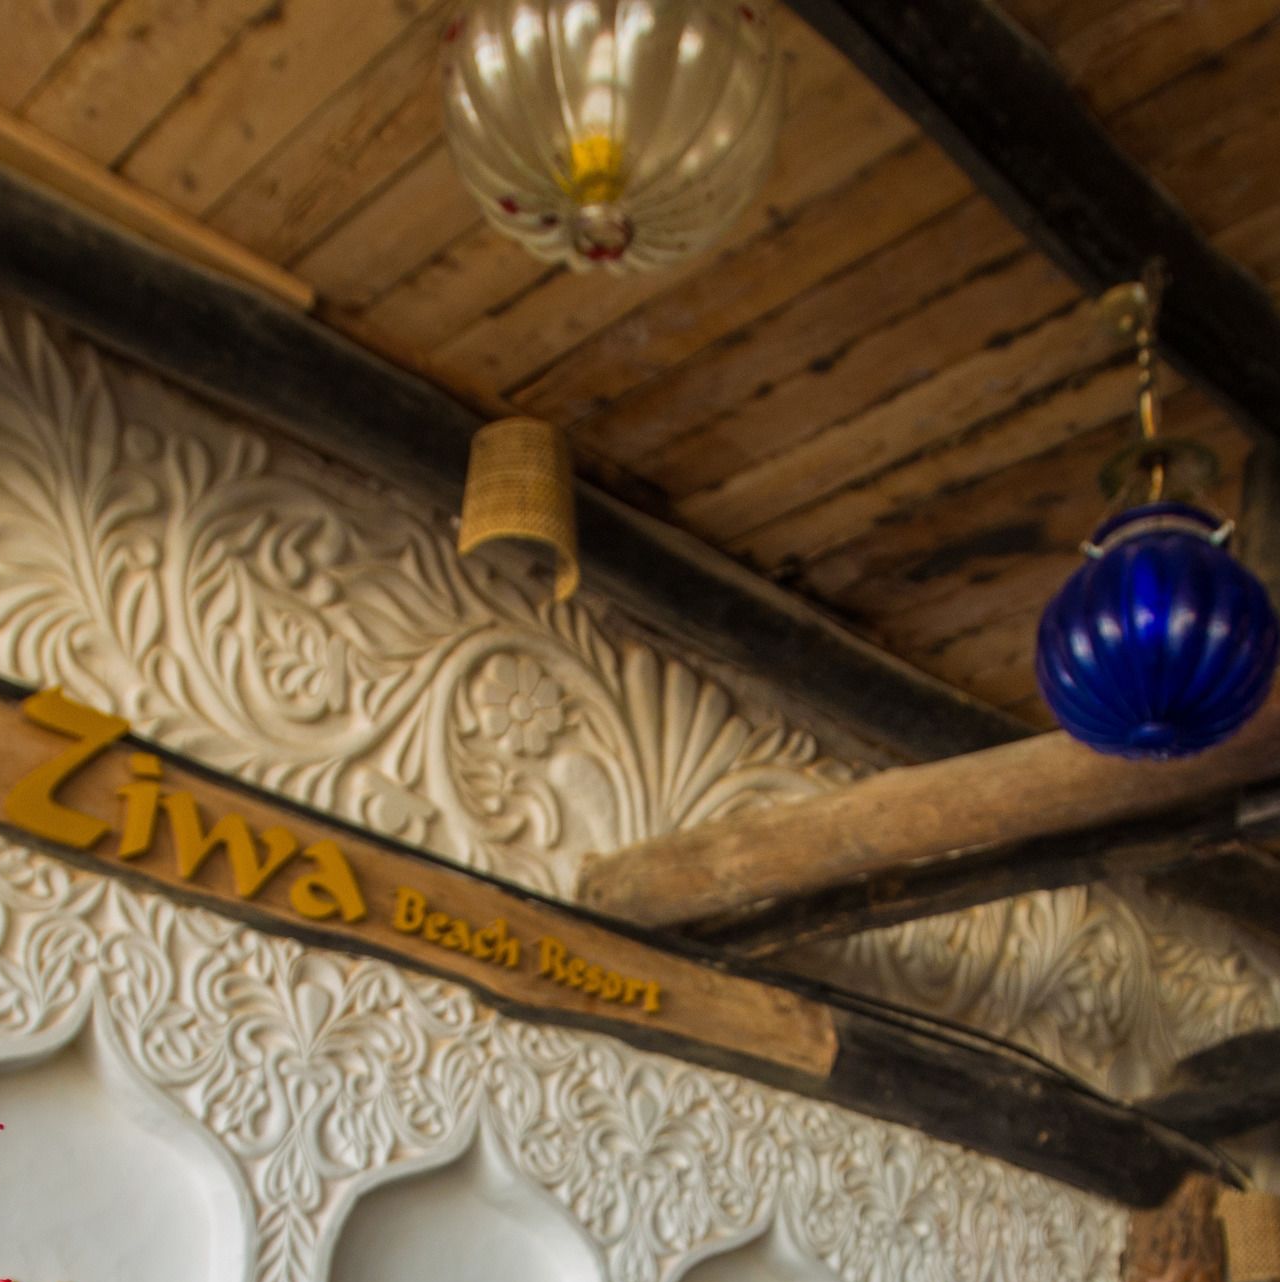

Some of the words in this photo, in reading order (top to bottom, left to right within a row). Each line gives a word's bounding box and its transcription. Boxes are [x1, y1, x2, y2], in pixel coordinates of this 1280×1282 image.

[4, 686, 366, 924] Ziwa
[392, 886, 520, 969] Beach
[536, 935, 661, 1014] Resort
